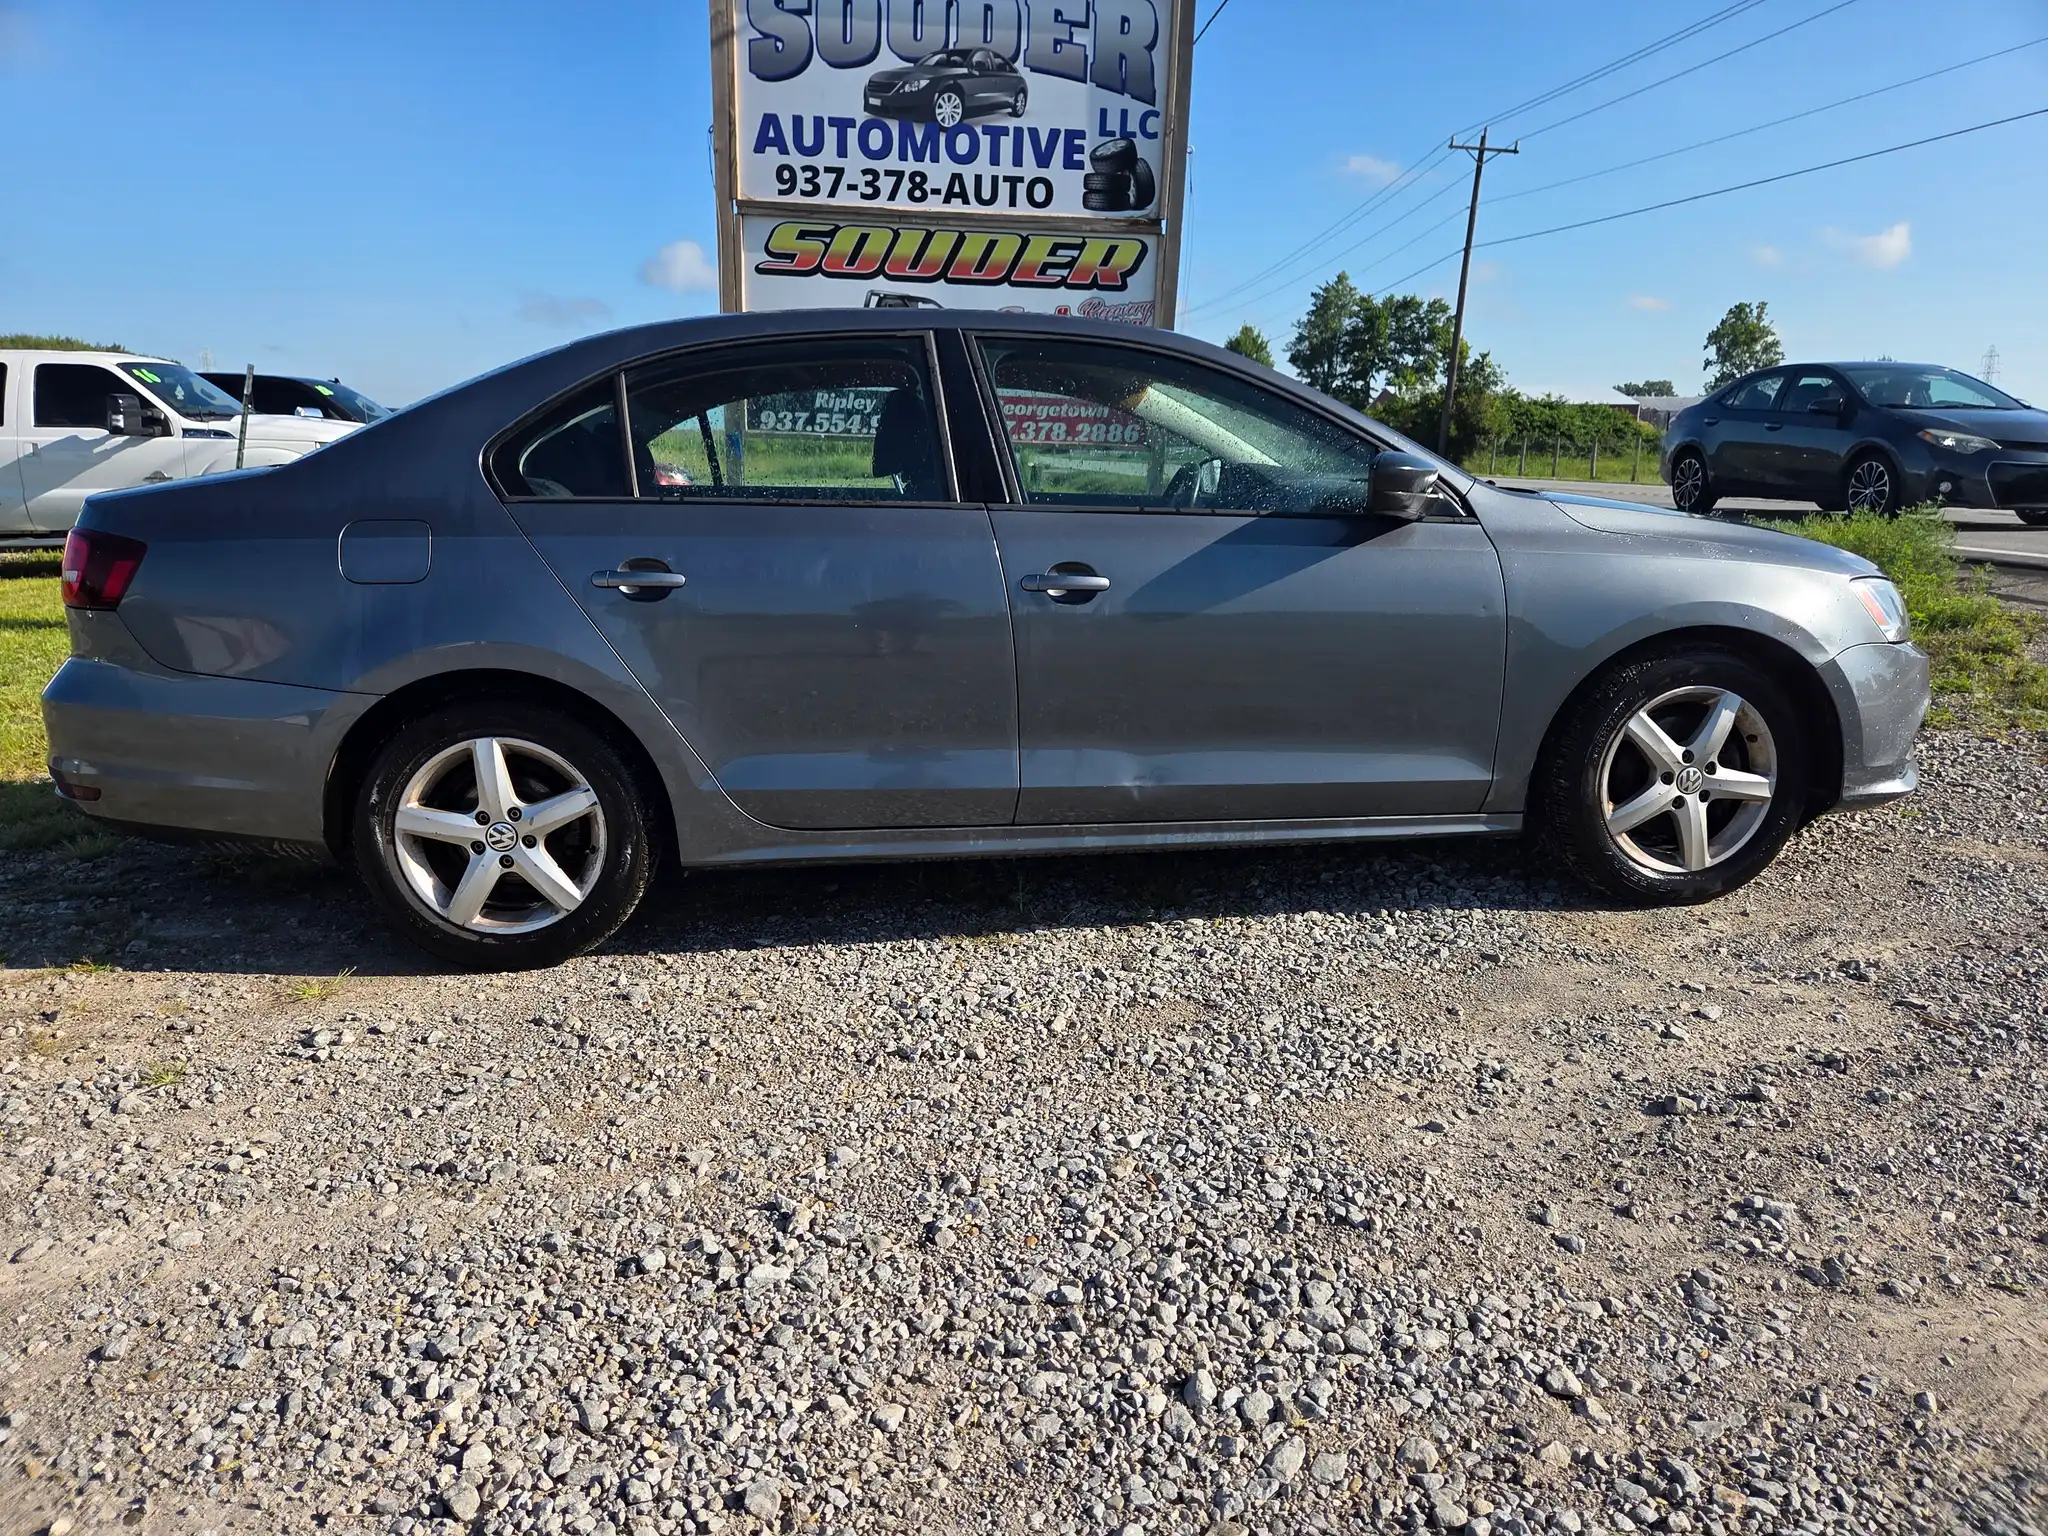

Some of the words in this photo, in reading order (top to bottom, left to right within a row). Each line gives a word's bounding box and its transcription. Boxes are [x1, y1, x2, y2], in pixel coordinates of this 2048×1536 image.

[748, 0, 1157, 107] SOUDER
[753, 112, 1087, 171] AUTOMOTIVE
[1098, 107, 1161, 140] LLC
[775, 163, 1055, 209] 937-378-AUTO
[754, 221, 1149, 292] SOUDER
[814, 391, 877, 414] Ripley
[1000, 399, 1110, 420] eorgetown
